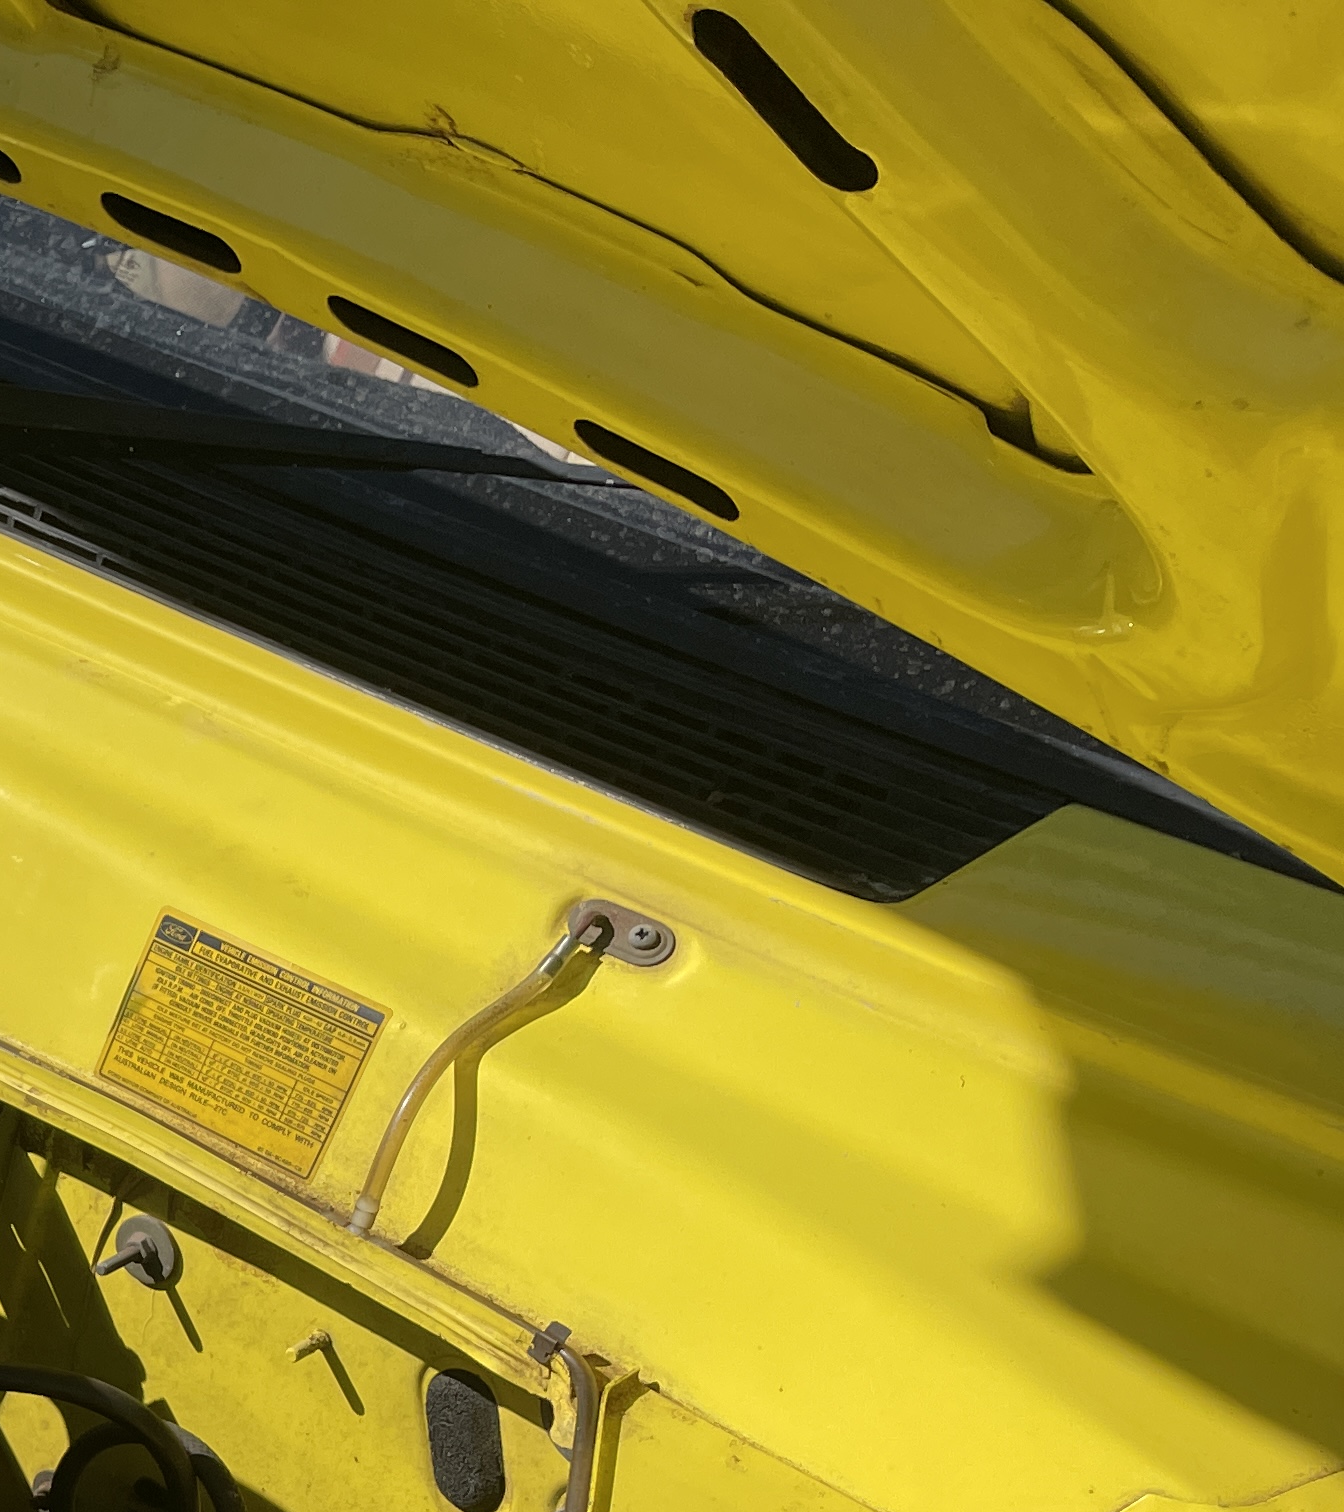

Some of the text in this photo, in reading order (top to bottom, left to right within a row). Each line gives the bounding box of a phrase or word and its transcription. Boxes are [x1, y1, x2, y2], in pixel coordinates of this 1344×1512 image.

[163, 921, 188, 942] Ford
[153, 943, 336, 1035] ENGINE FAMILY IDENTIFICATION SPARK PLUG GAP
[198, 945, 214, 958] FUEL
[214, 952, 259, 979] EVAPORATIVE
[258, 973, 274, 987] AND
[273, 980, 306, 1001] EXHAUST
[305, 995, 338, 1016] EMISSION
[338, 1010, 370, 1031] CONTROL
[219, 942, 360, 1013] VEHICLE EMISSION CONTROL INFORMATION
[231, 1003, 244, 1013] AND
[243, 1008, 257, 1020] PLUG
[234, 992, 242, 1001] AT
[295, 1022, 333, 1044] TEMPERATURE
[113, 1053, 156, 1080] AUSTRALIAN
[158, 1076, 187, 1095] DESIGN
[117, 1045, 134, 1058] THIS
[135, 1054, 165, 1074] VEHICLE
[168, 1070, 185, 1084] WAS
[186, 1080, 246, 1114] MANUFACTURED
[248, 1111, 260, 1121] TO
[260, 1117, 292, 1138] COMPLY
[293, 1134, 314, 1149] WITH
[121, 1076, 139, 1089] MOTOR
[138, 1085, 162, 1101] COMPANY
[162, 1097, 170, 1105] OF
[169, 1101, 197, 1119] AUSTRALIA
